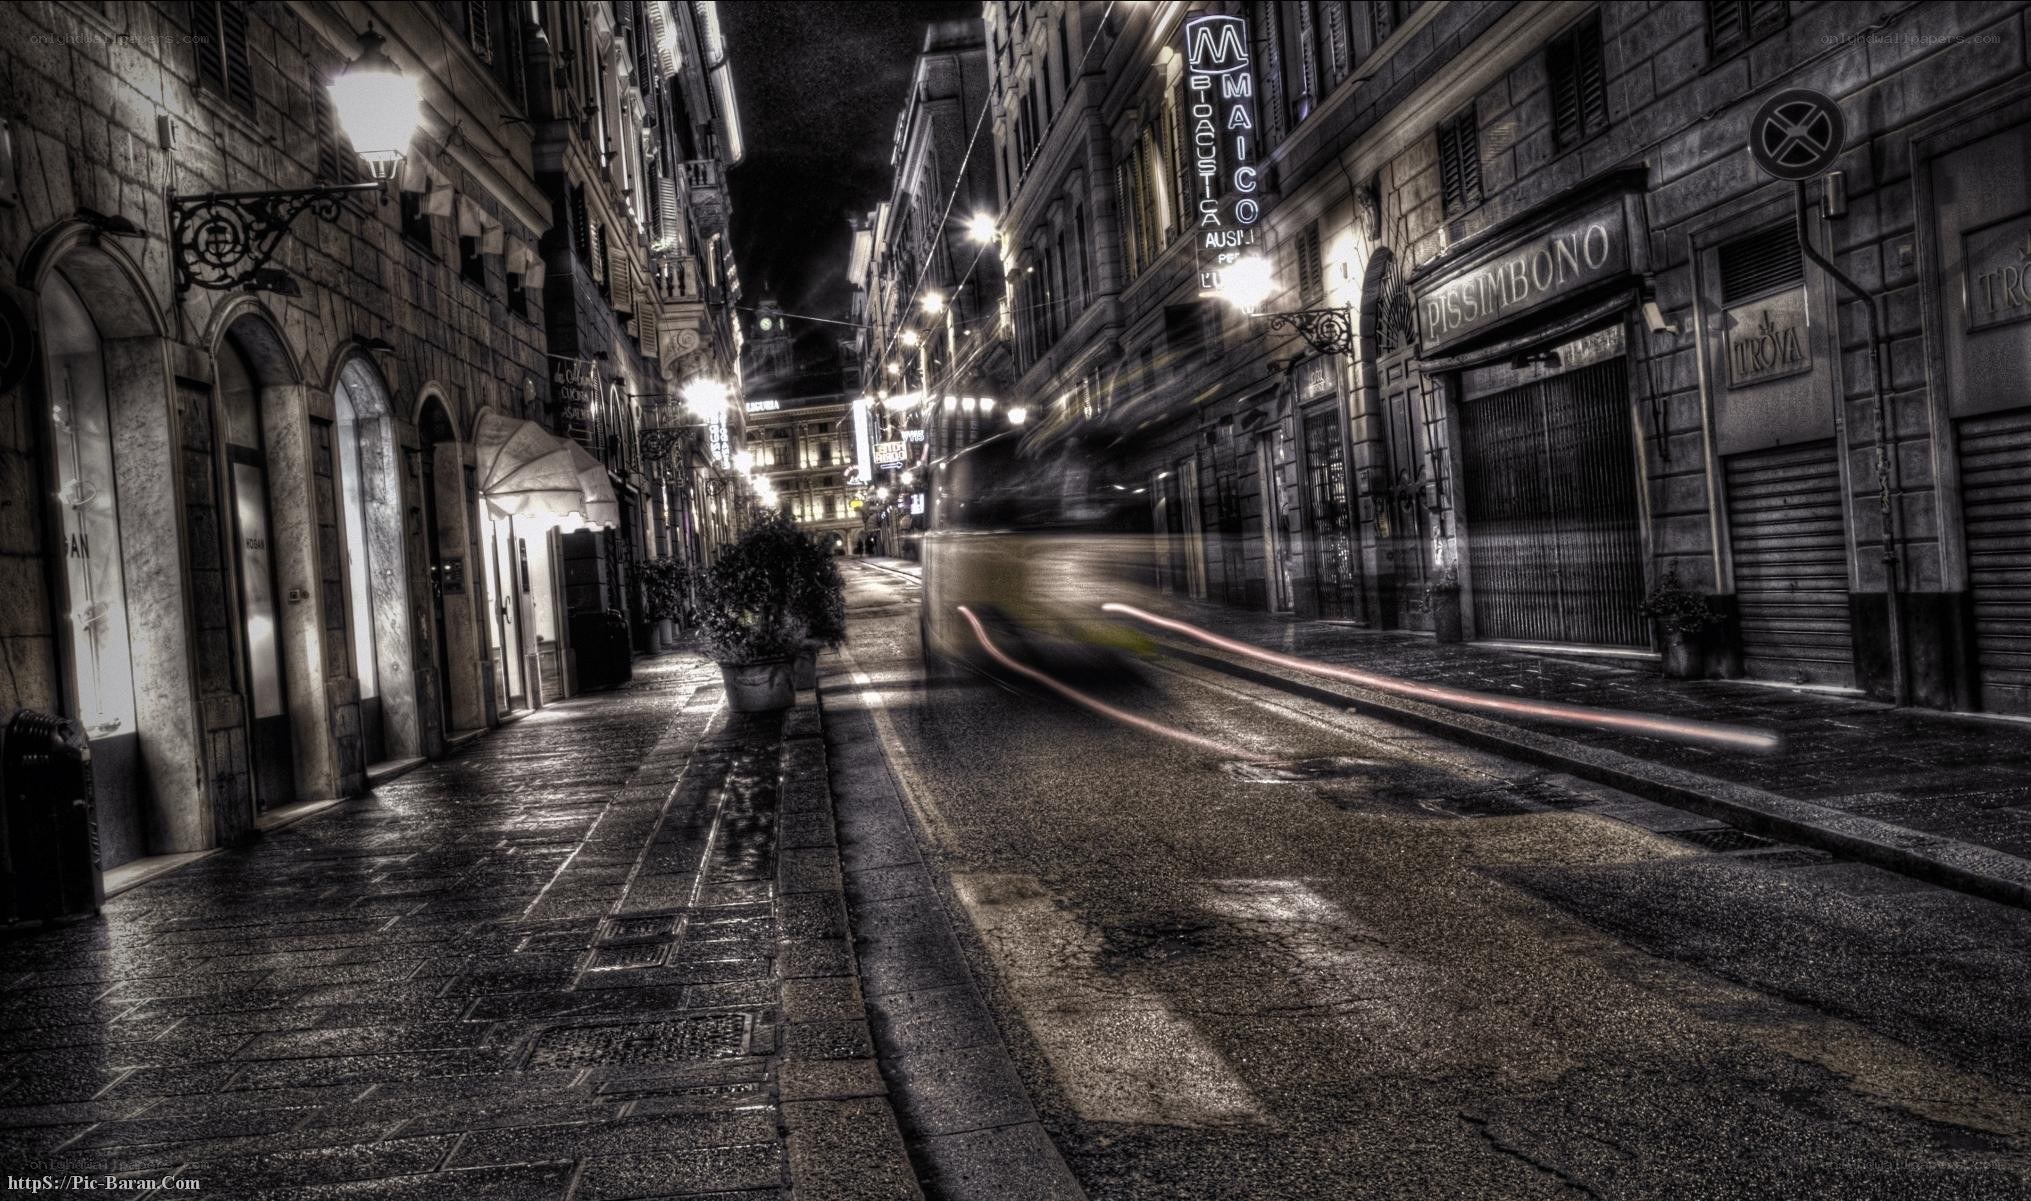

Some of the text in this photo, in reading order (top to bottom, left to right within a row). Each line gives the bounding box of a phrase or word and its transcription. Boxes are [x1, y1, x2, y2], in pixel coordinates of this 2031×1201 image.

[1191, 75, 1221, 227] BIOACUSTICA
[1222, 73, 1259, 224] MAICO
[1427, 224, 1609, 339] PISSIMBONO
[1734, 326, 1806, 376] TROVA
[246, 538, 265, 550] HOGAN
